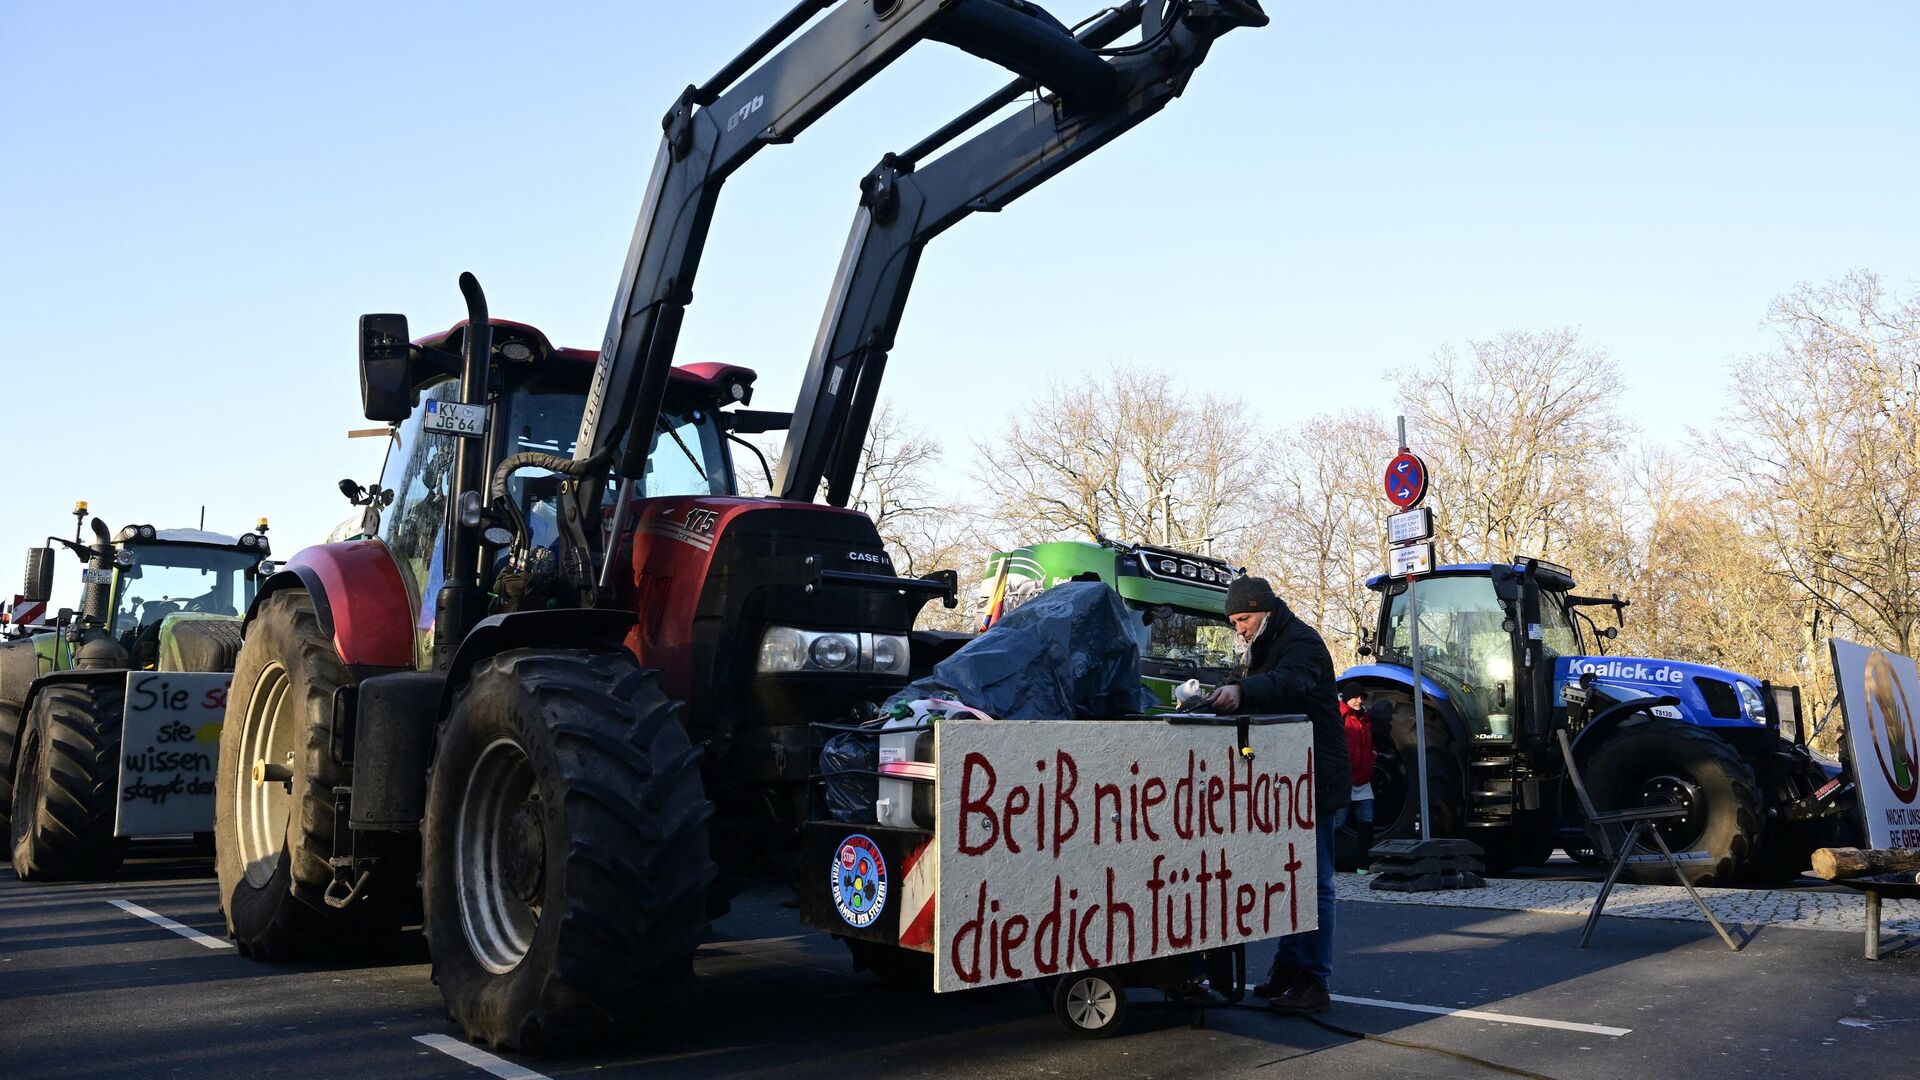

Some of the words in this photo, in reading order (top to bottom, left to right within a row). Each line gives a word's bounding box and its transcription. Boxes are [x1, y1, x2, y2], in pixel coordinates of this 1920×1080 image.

[440, 403, 457, 416] KY
[436, 416, 454, 429] JG
[458, 418, 475, 431] 64
[684, 508, 719, 534] 175
[848, 551, 879, 563] CASE
[1568, 658, 1684, 683] Koalick.de
[132, 676, 189, 711] Sie
[1655, 709, 1673, 718] TS130
[156, 720, 195, 743] sie
[126, 747, 211, 772] wissen
[123, 774, 184, 804] stoppt
[958, 748, 1080, 859] Beiß
[1094, 760, 1167, 845] nie
[1173, 749, 1225, 840] die
[1229, 745, 1315, 835] Hand
[1886, 808, 1907, 826] NICHT
[843, 852, 855, 863] STOP
[832, 857, 842, 884] ZIEHT
[833, 885, 843, 904] DER
[839, 902, 857, 924] AMPEL
[857, 912, 870, 925] DEN
[951, 880, 1030, 983] die
[1034, 866, 1135, 975] dich
[1146, 842, 1303, 956] füttert
